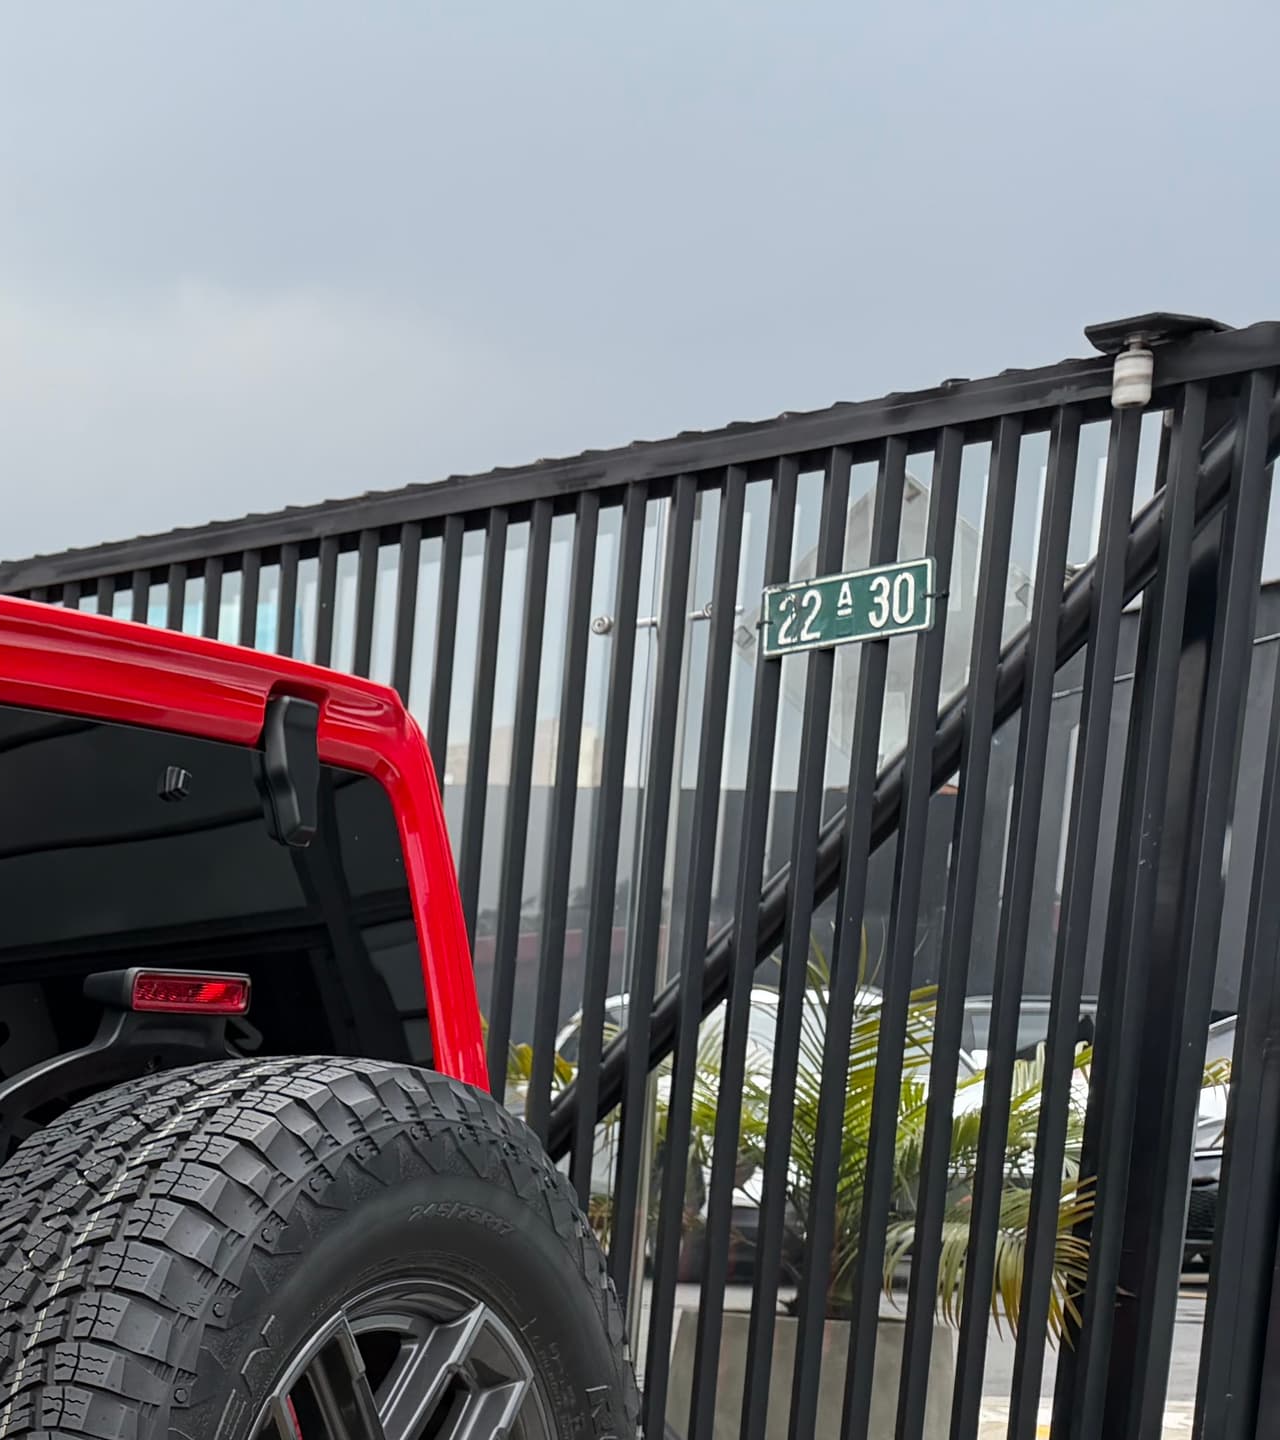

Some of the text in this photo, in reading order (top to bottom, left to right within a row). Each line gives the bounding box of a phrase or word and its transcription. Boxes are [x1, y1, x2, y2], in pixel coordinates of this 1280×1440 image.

[778, 571, 916, 646] 22 A 30
